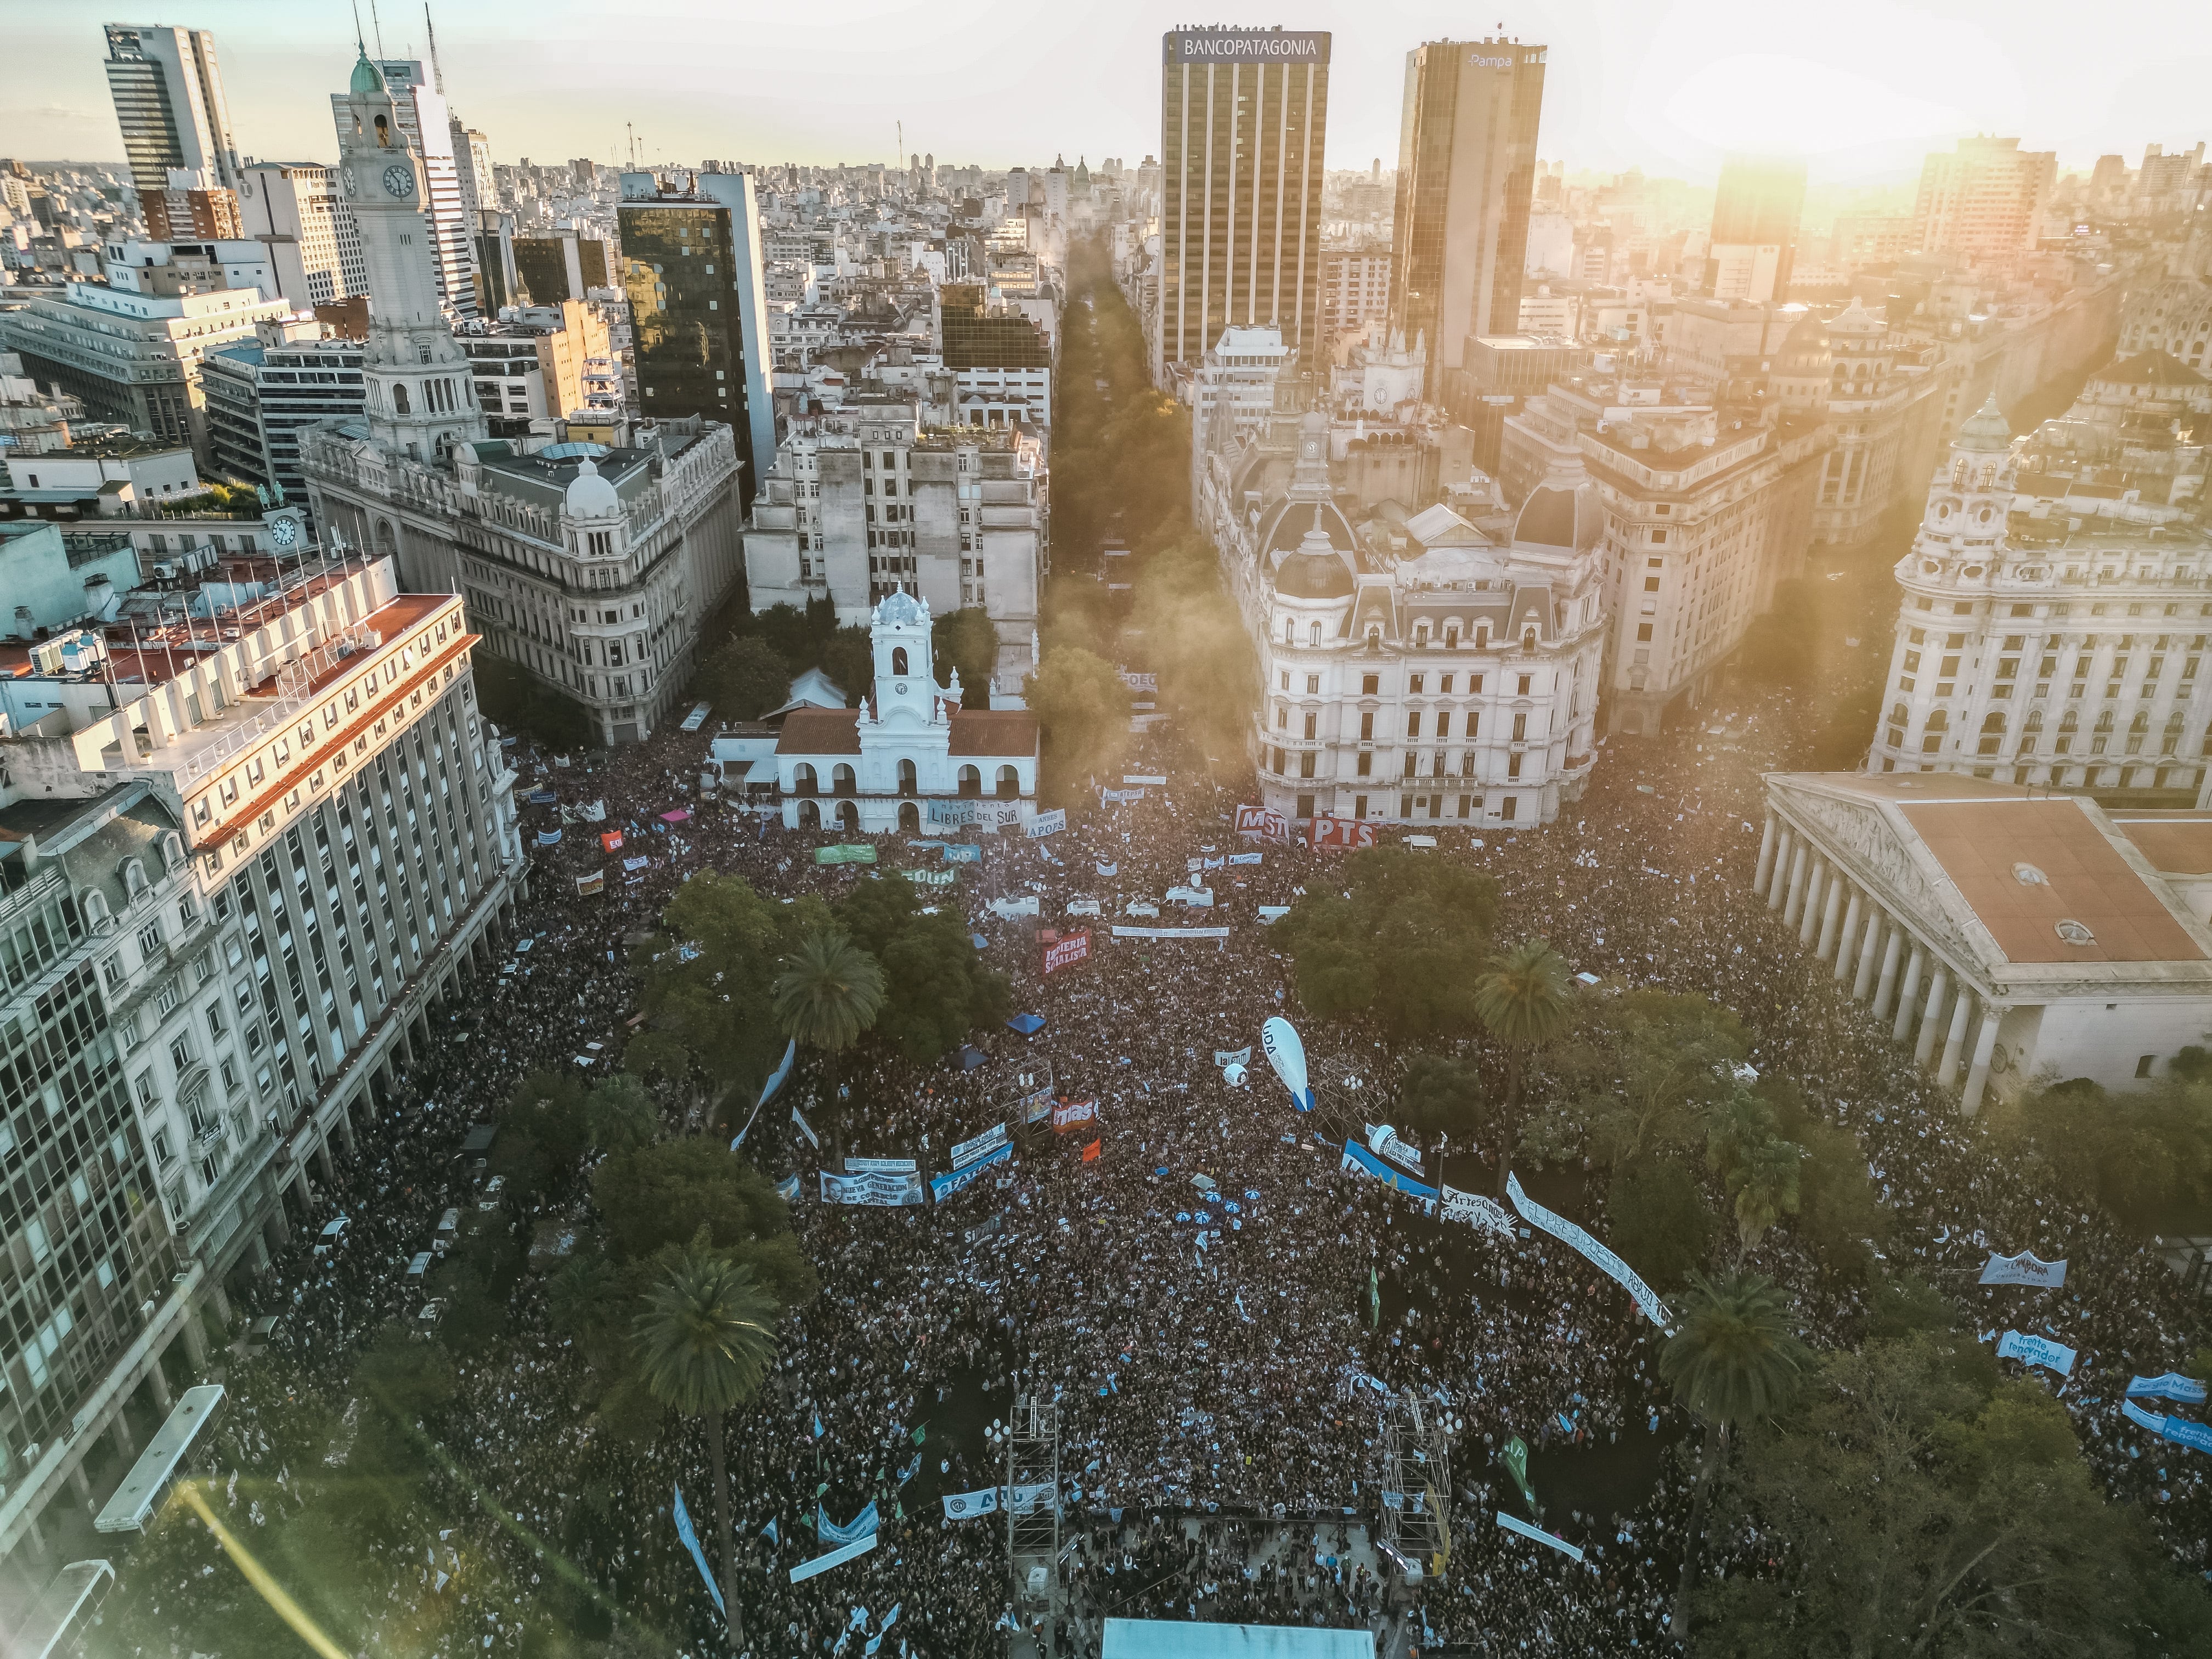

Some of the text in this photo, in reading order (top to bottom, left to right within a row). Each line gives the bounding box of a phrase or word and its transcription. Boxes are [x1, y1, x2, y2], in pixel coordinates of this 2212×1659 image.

[1184, 40, 1317, 55] BANCOPATAGONIA
[1468, 54, 1512, 70] Pampa
[932, 808, 1018, 825] LIBRES DEL SUR
[1038, 813, 1058, 823] ANSES
[1242, 810, 1286, 835] MST
[1029, 820, 1065, 838] APOPS
[1314, 820, 1373, 848] PTS
[1262, 1024, 1277, 1055] UDA
[843, 1181, 907, 1194] NUEVA GENERACION
[1446, 1189, 1503, 1219] Artesanos
[1996, 1273, 2048, 1283] UNIVERSIDAD
[1628, 1271, 1654, 1306] ABAJO
[2019, 1335, 2047, 1350] frente
[2008, 1342, 2061, 1363] renovador
[2171, 1380, 2207, 1394] Mass
